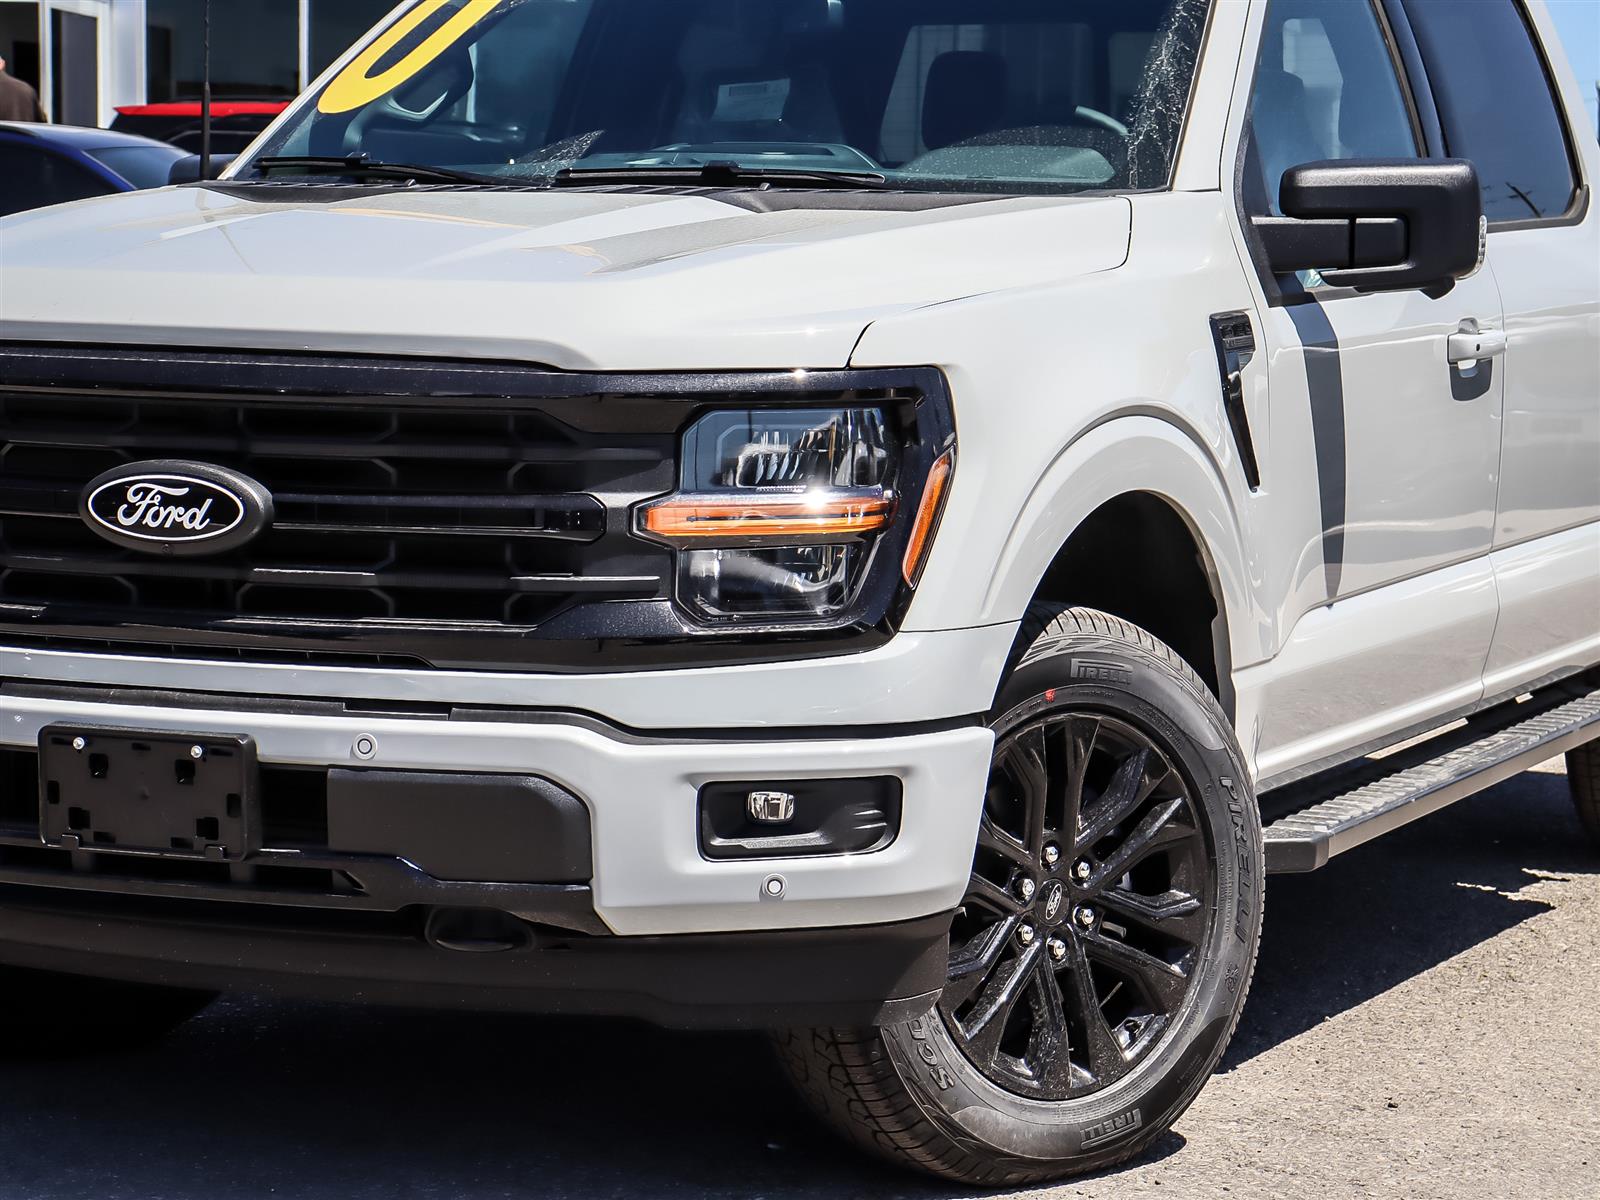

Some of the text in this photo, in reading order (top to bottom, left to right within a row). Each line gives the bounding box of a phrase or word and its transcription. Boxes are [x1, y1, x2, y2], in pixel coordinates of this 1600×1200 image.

[117, 483, 213, 530] Ford
[1071, 658, 1134, 685] PIRELLI
[1219, 776, 1251, 943] PIRELLI
[1080, 1108, 1142, 1150] PIRELLI
